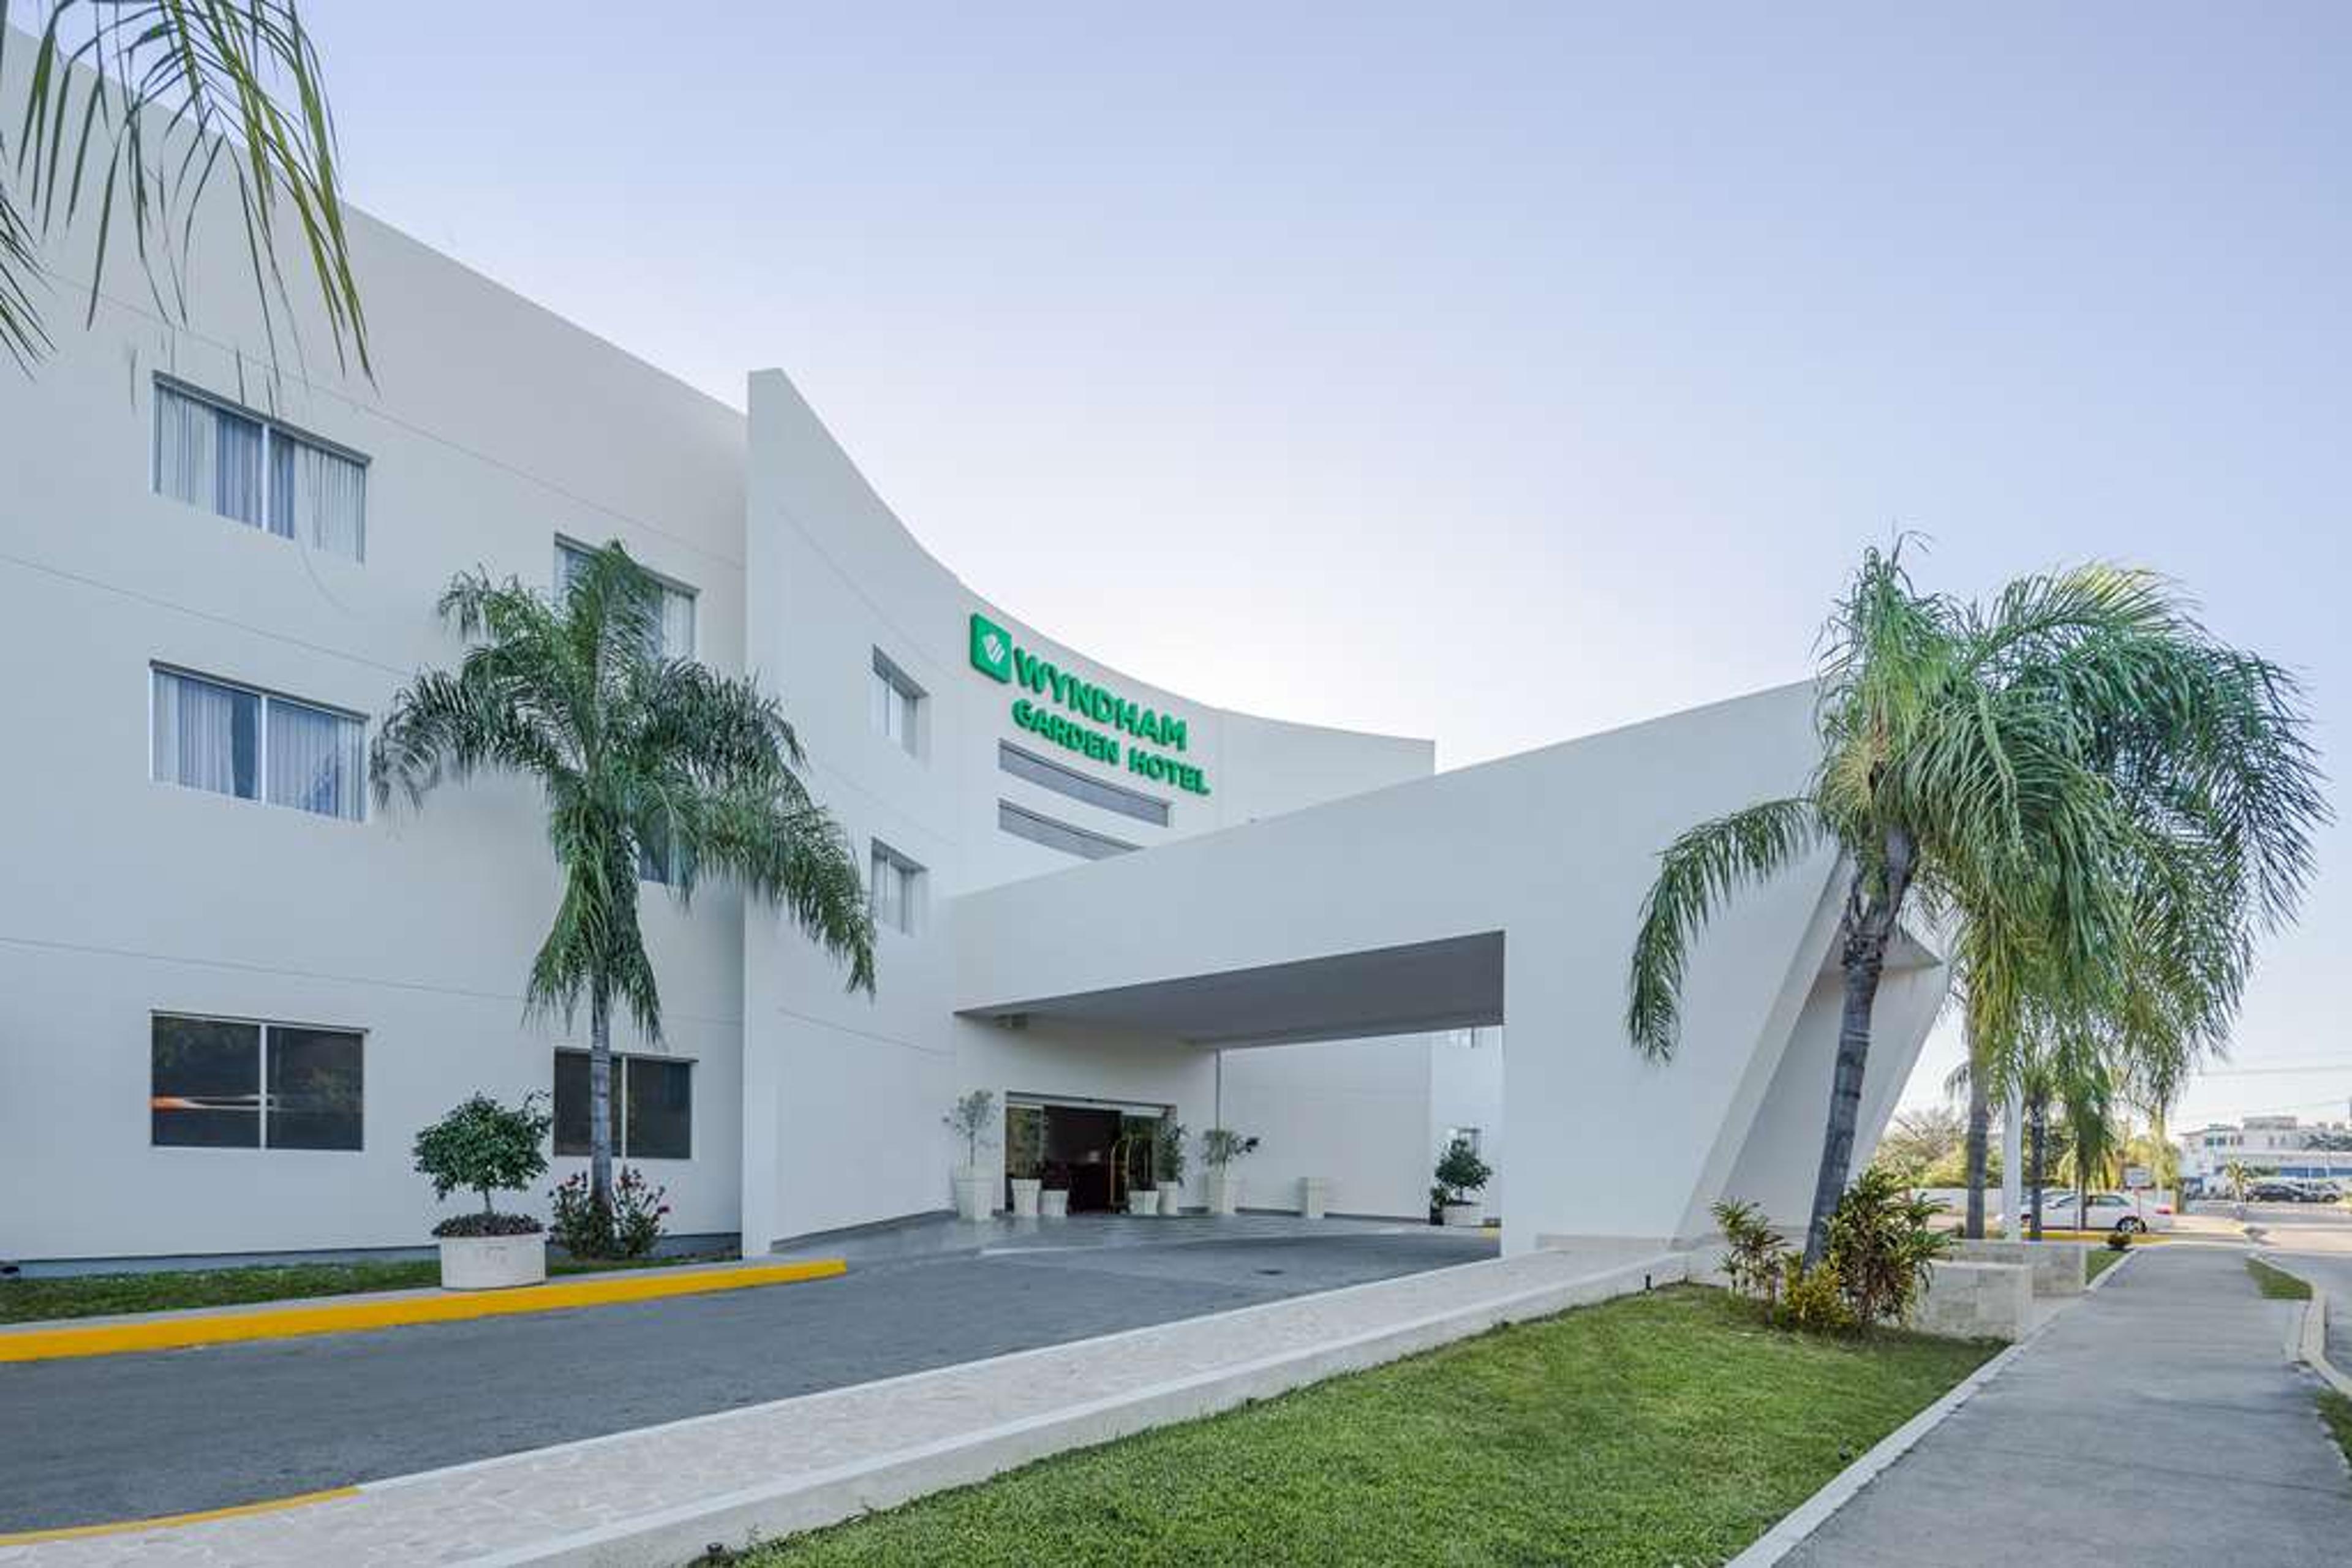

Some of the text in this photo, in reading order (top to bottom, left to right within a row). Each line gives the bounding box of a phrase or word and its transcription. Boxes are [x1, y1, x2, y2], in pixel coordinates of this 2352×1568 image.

[1012, 698, 1210, 795] GARDEN HOTEL
[1013, 646, 1187, 752] WYNDHAM
